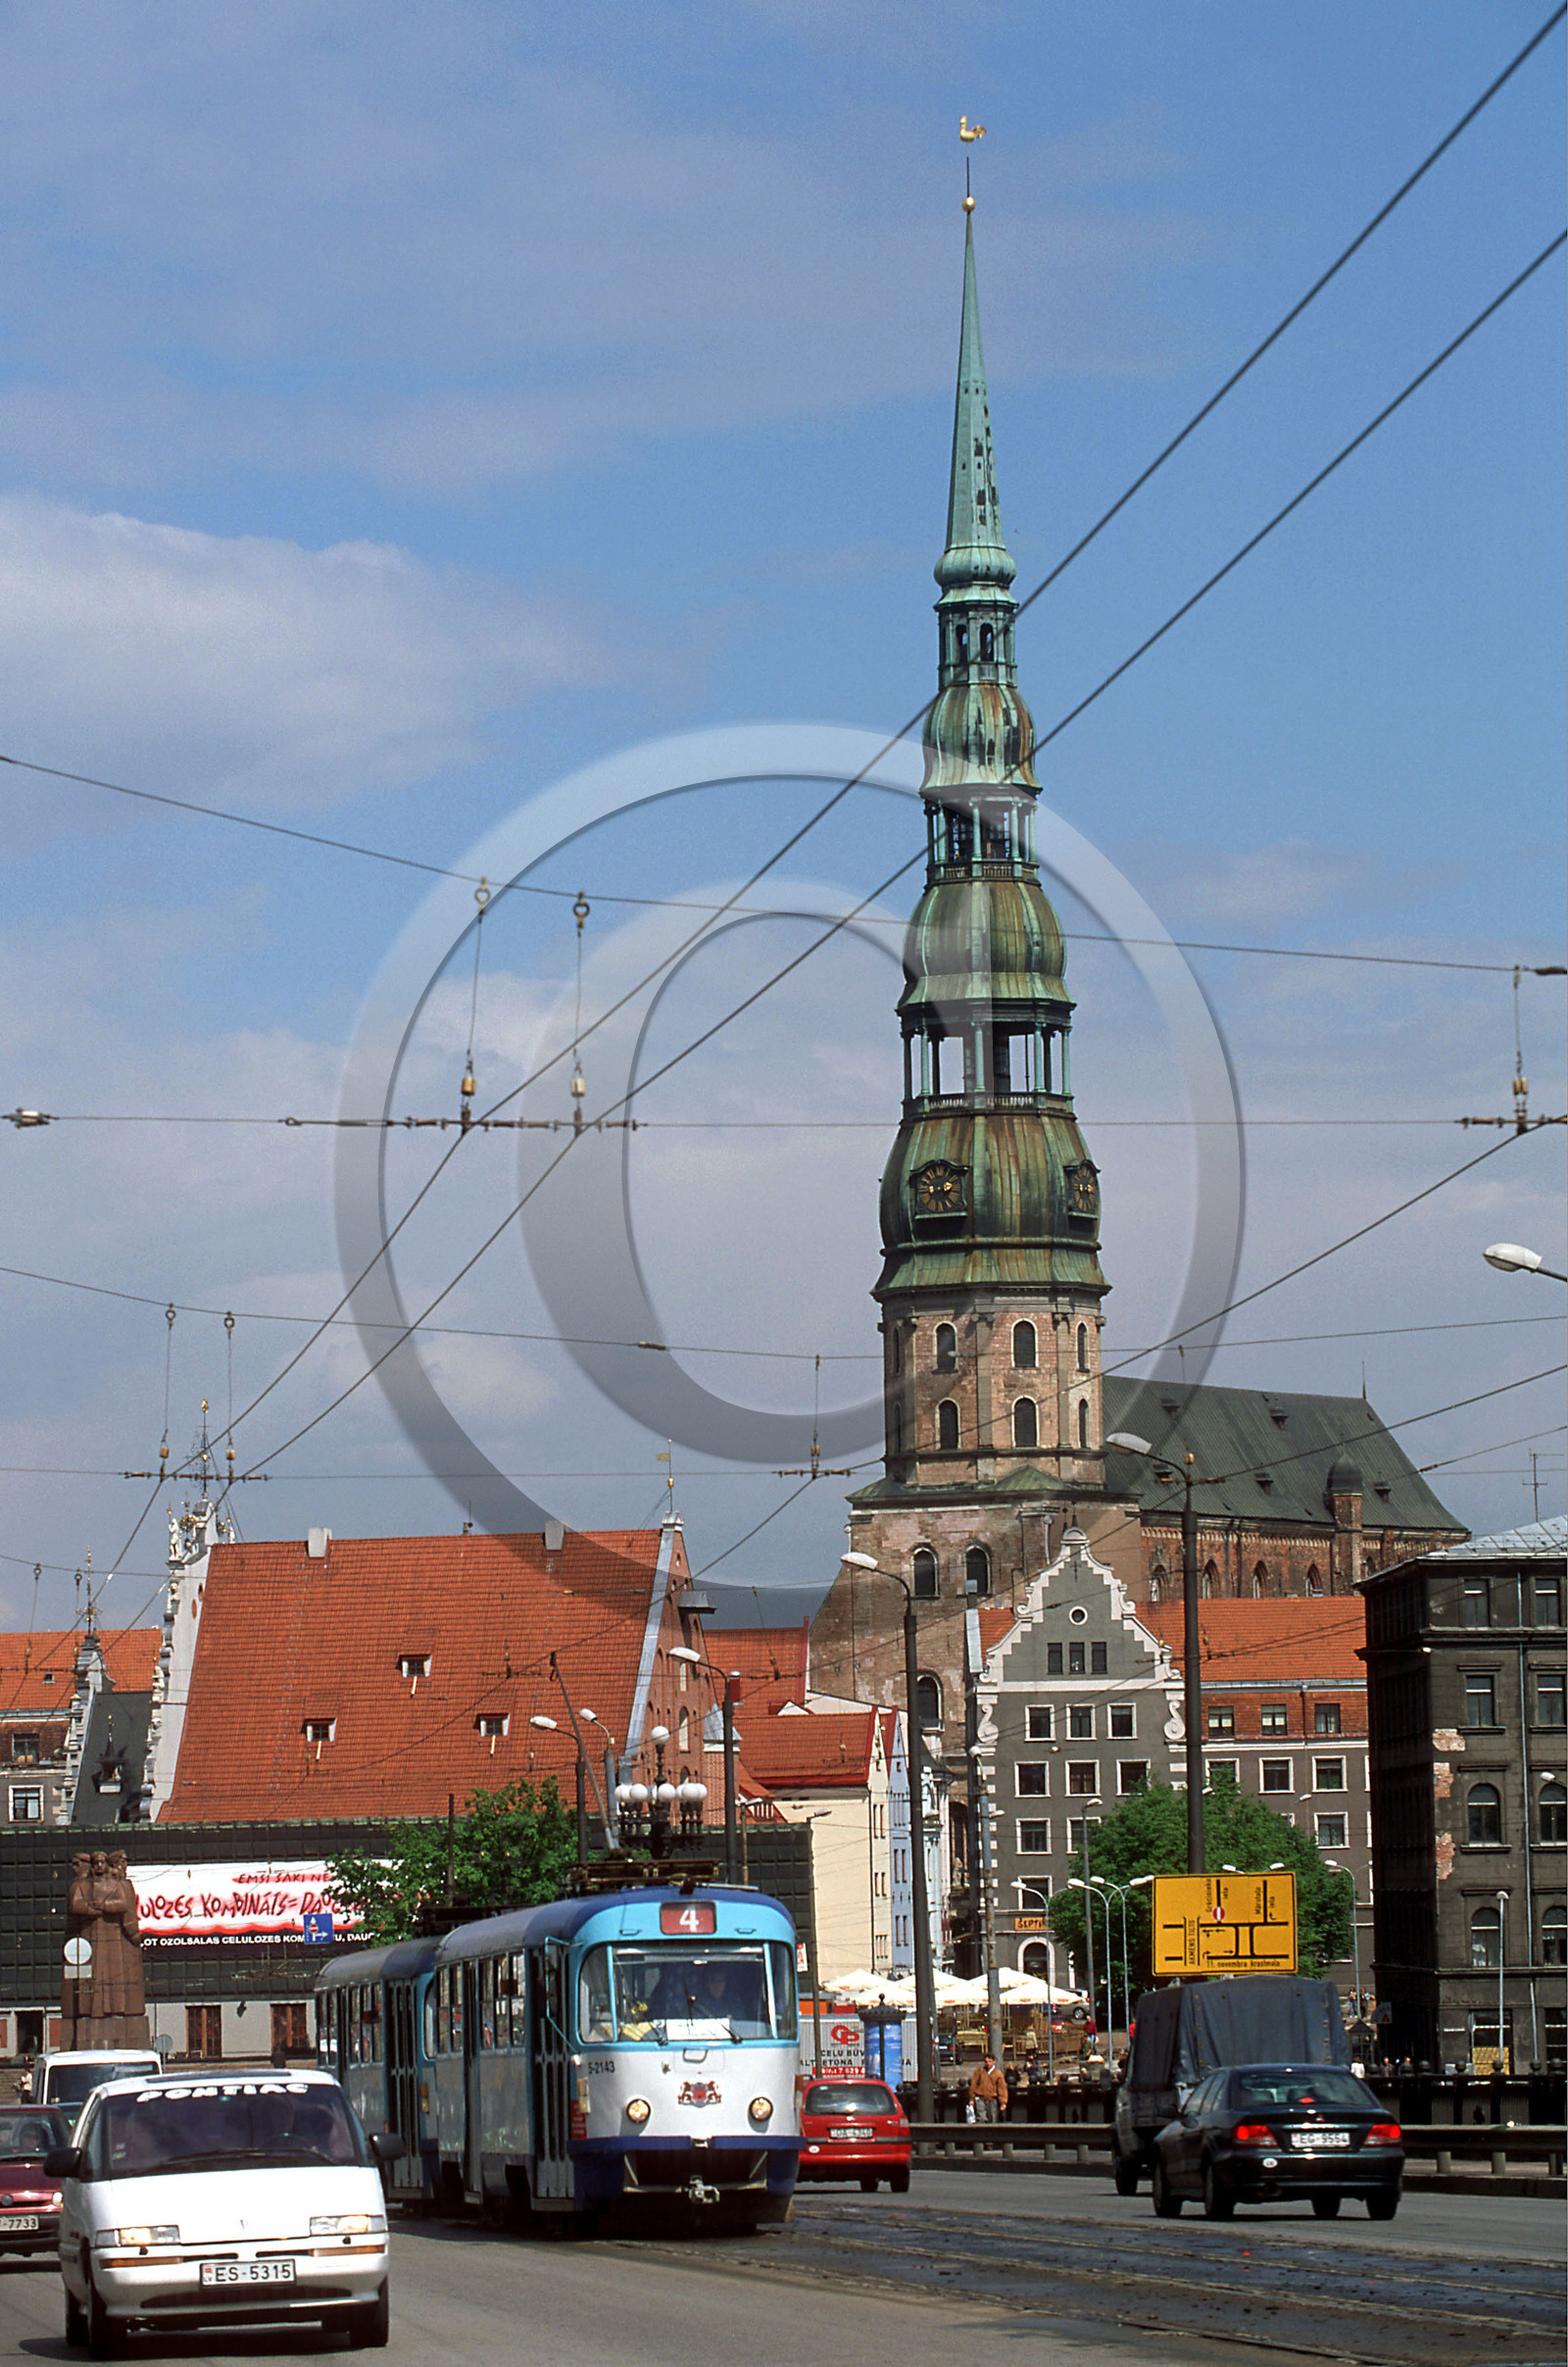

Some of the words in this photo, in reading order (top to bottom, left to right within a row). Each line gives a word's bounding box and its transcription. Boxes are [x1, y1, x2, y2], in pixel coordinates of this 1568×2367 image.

[679, 1906, 700, 1933] 4
[160, 1936, 220, 1947] OZOLSALAS
[221, 1934, 281, 1946] CELULOZES
[1217, 1959, 1248, 1968] novembra
[1250, 1958, 1280, 1967] krastmala
[588, 2060, 615, 2075] 5-2143
[136, 2083, 310, 2103] PONTIAC
[0, 2217, 37, 2230] -7733
[216, 2263, 291, 2283] ES-5315
